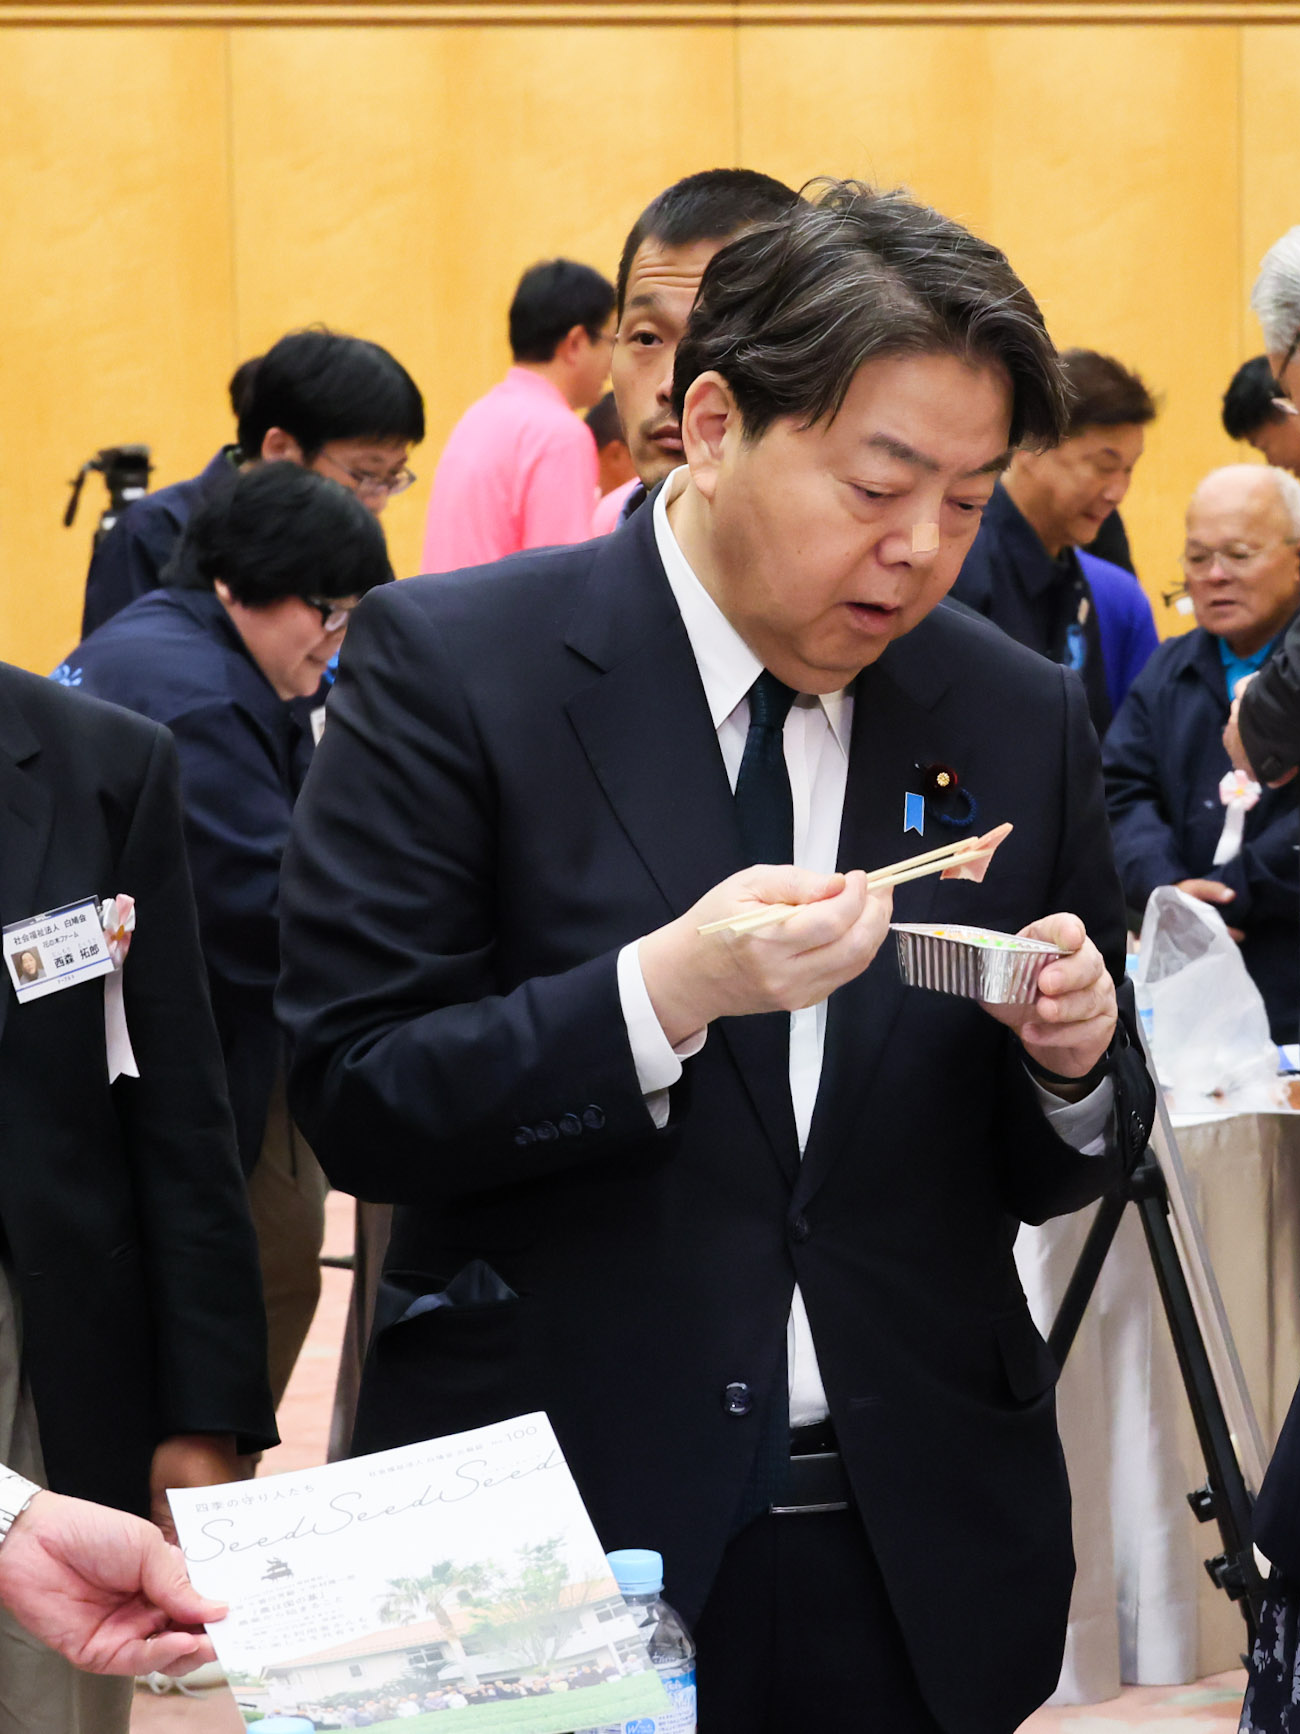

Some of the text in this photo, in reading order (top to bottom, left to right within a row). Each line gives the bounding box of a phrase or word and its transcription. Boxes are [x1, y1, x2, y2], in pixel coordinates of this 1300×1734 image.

[13, 923, 60, 946] 社会福祉法人
[64, 914, 87, 929] 白鳩会
[54, 953, 75, 969] 西森
[79, 943, 100, 961] 拓郎
[506, 1425, 538, 1442] 100
[195, 1484, 315, 1513] 四季の守り人たち
